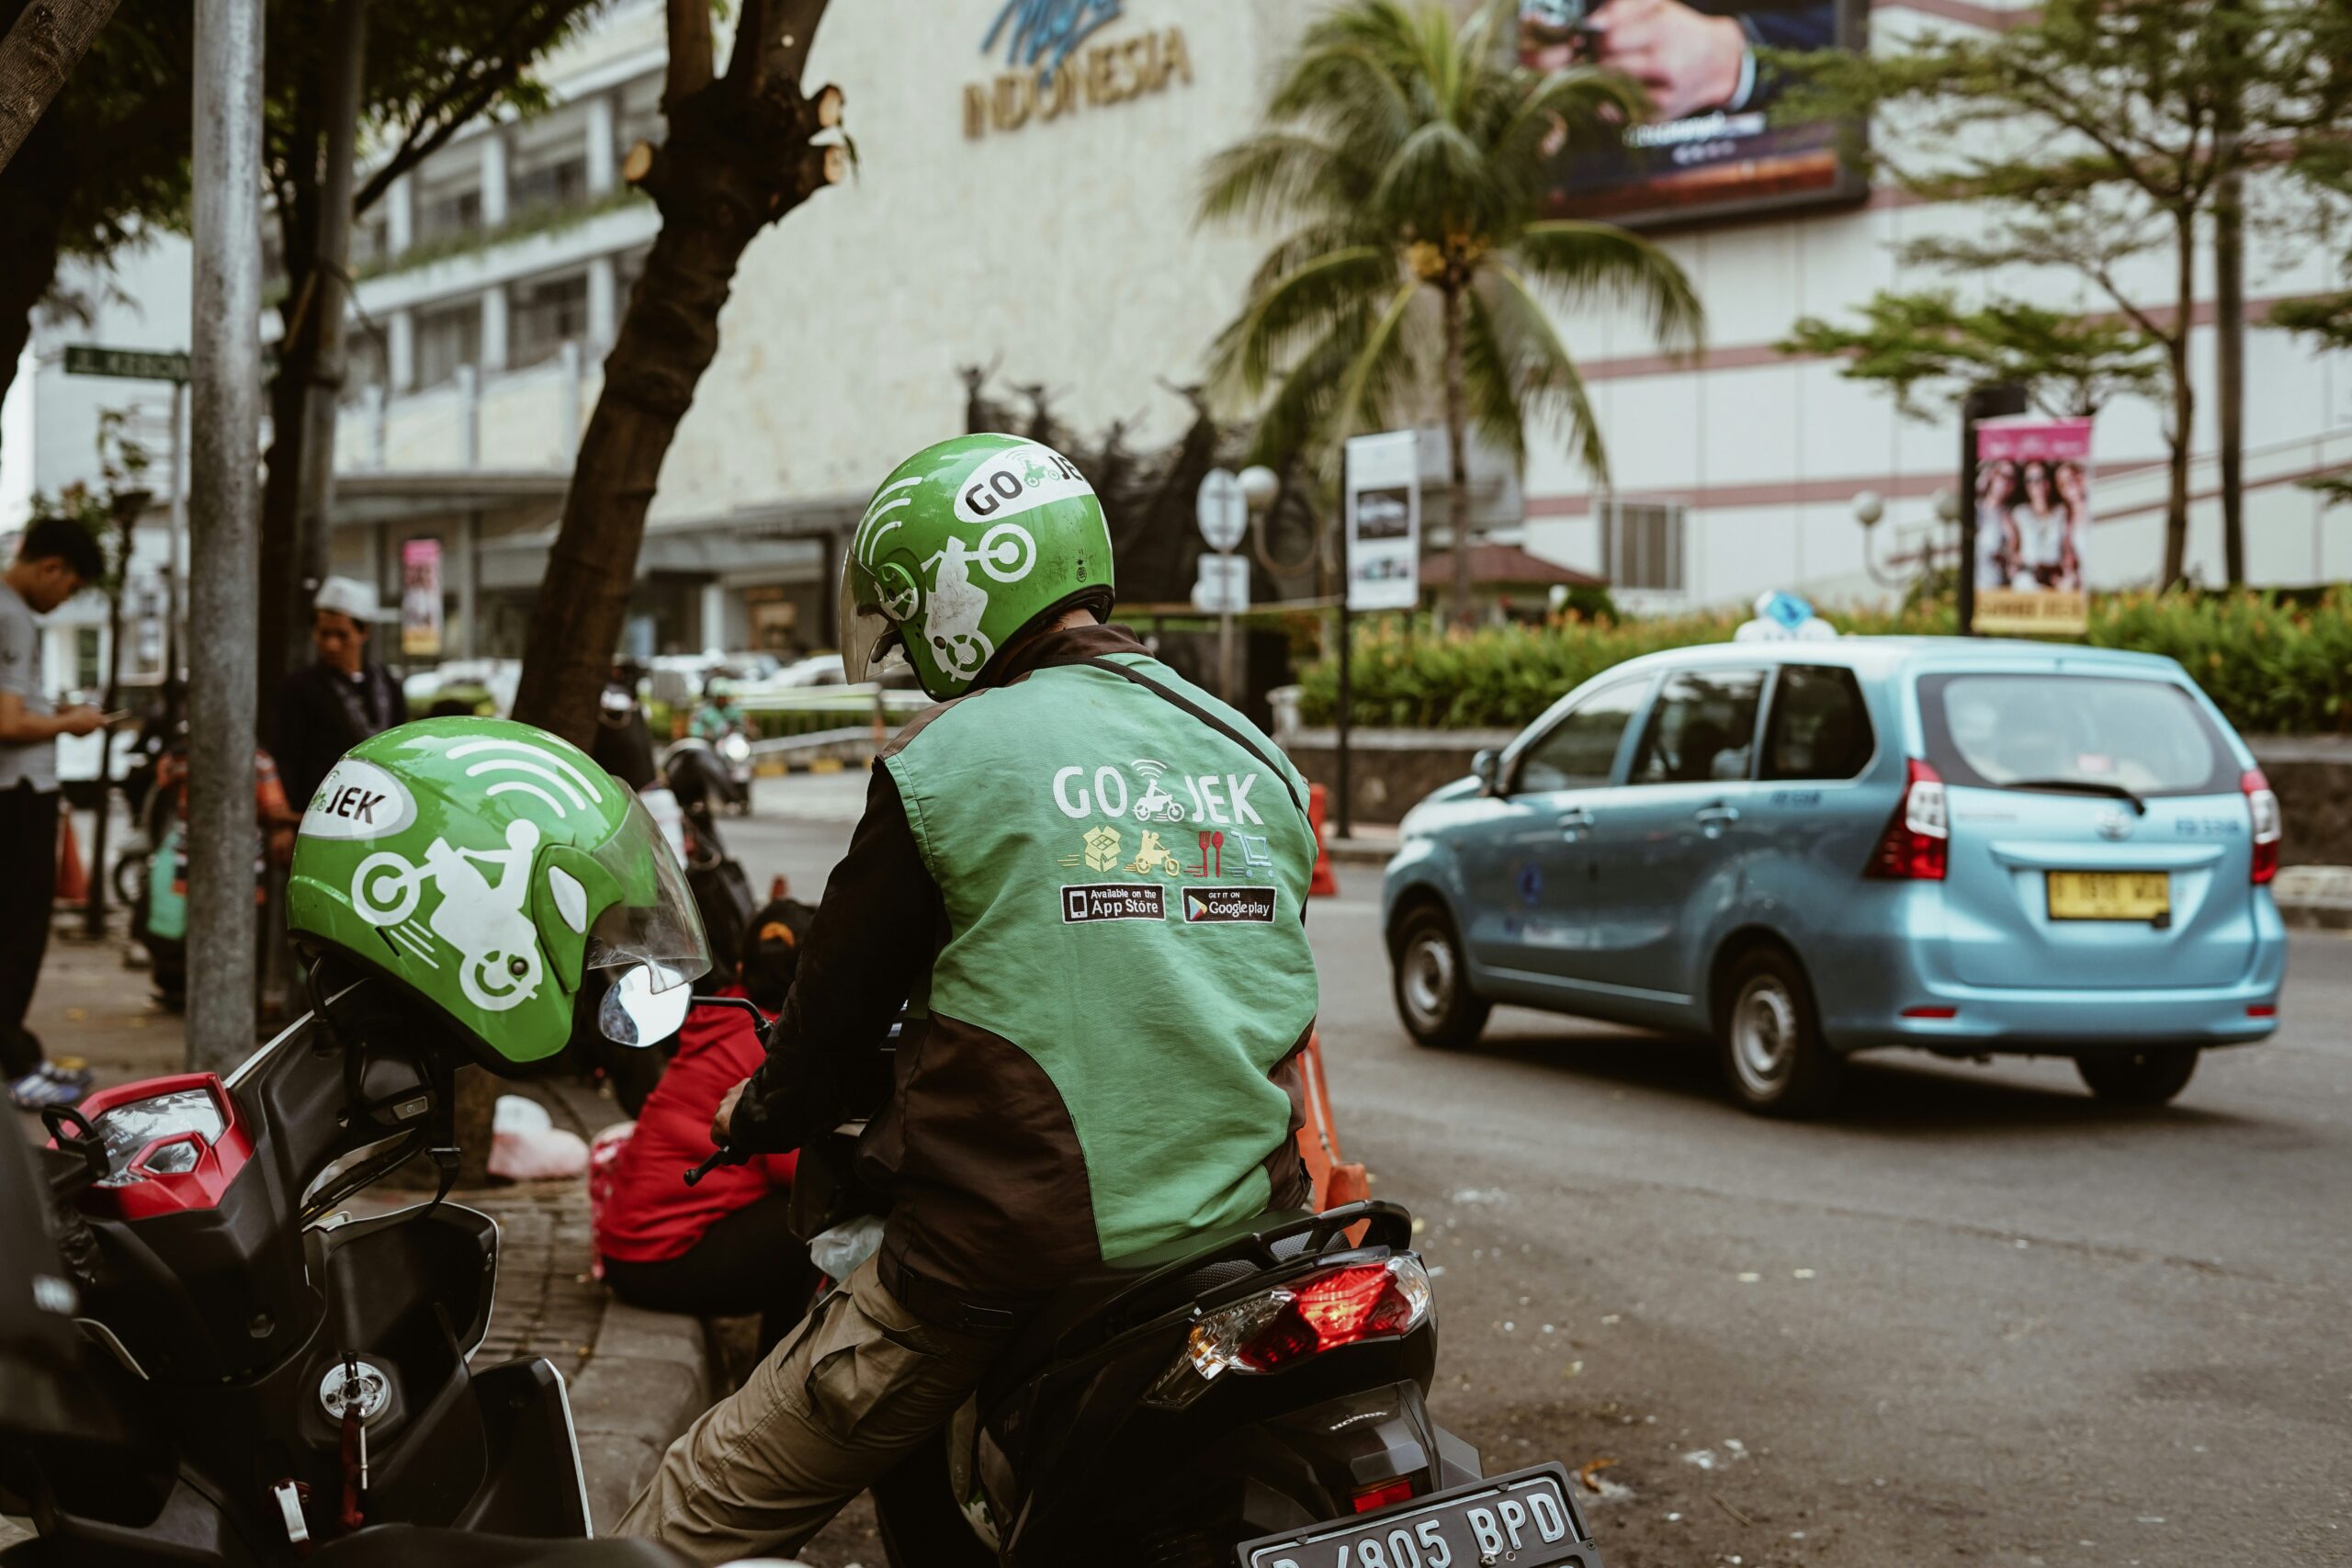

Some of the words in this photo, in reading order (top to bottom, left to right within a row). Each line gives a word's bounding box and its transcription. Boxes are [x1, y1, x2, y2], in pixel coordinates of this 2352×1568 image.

[962, 26, 1192, 141] INDONESIA
[965, 470, 1023, 516] GO
[1048, 456, 1088, 484] JE
[325, 784, 386, 825] JEK
[1053, 765, 1128, 819] GO
[1184, 773, 1265, 826] JEK
[1091, 889, 1128, 899] Available
[1145, 889, 1157, 899] the
[1091, 900, 1123, 917] App
[1209, 900, 1248, 918] Google
[1466, 1493, 1566, 1557] BPD
